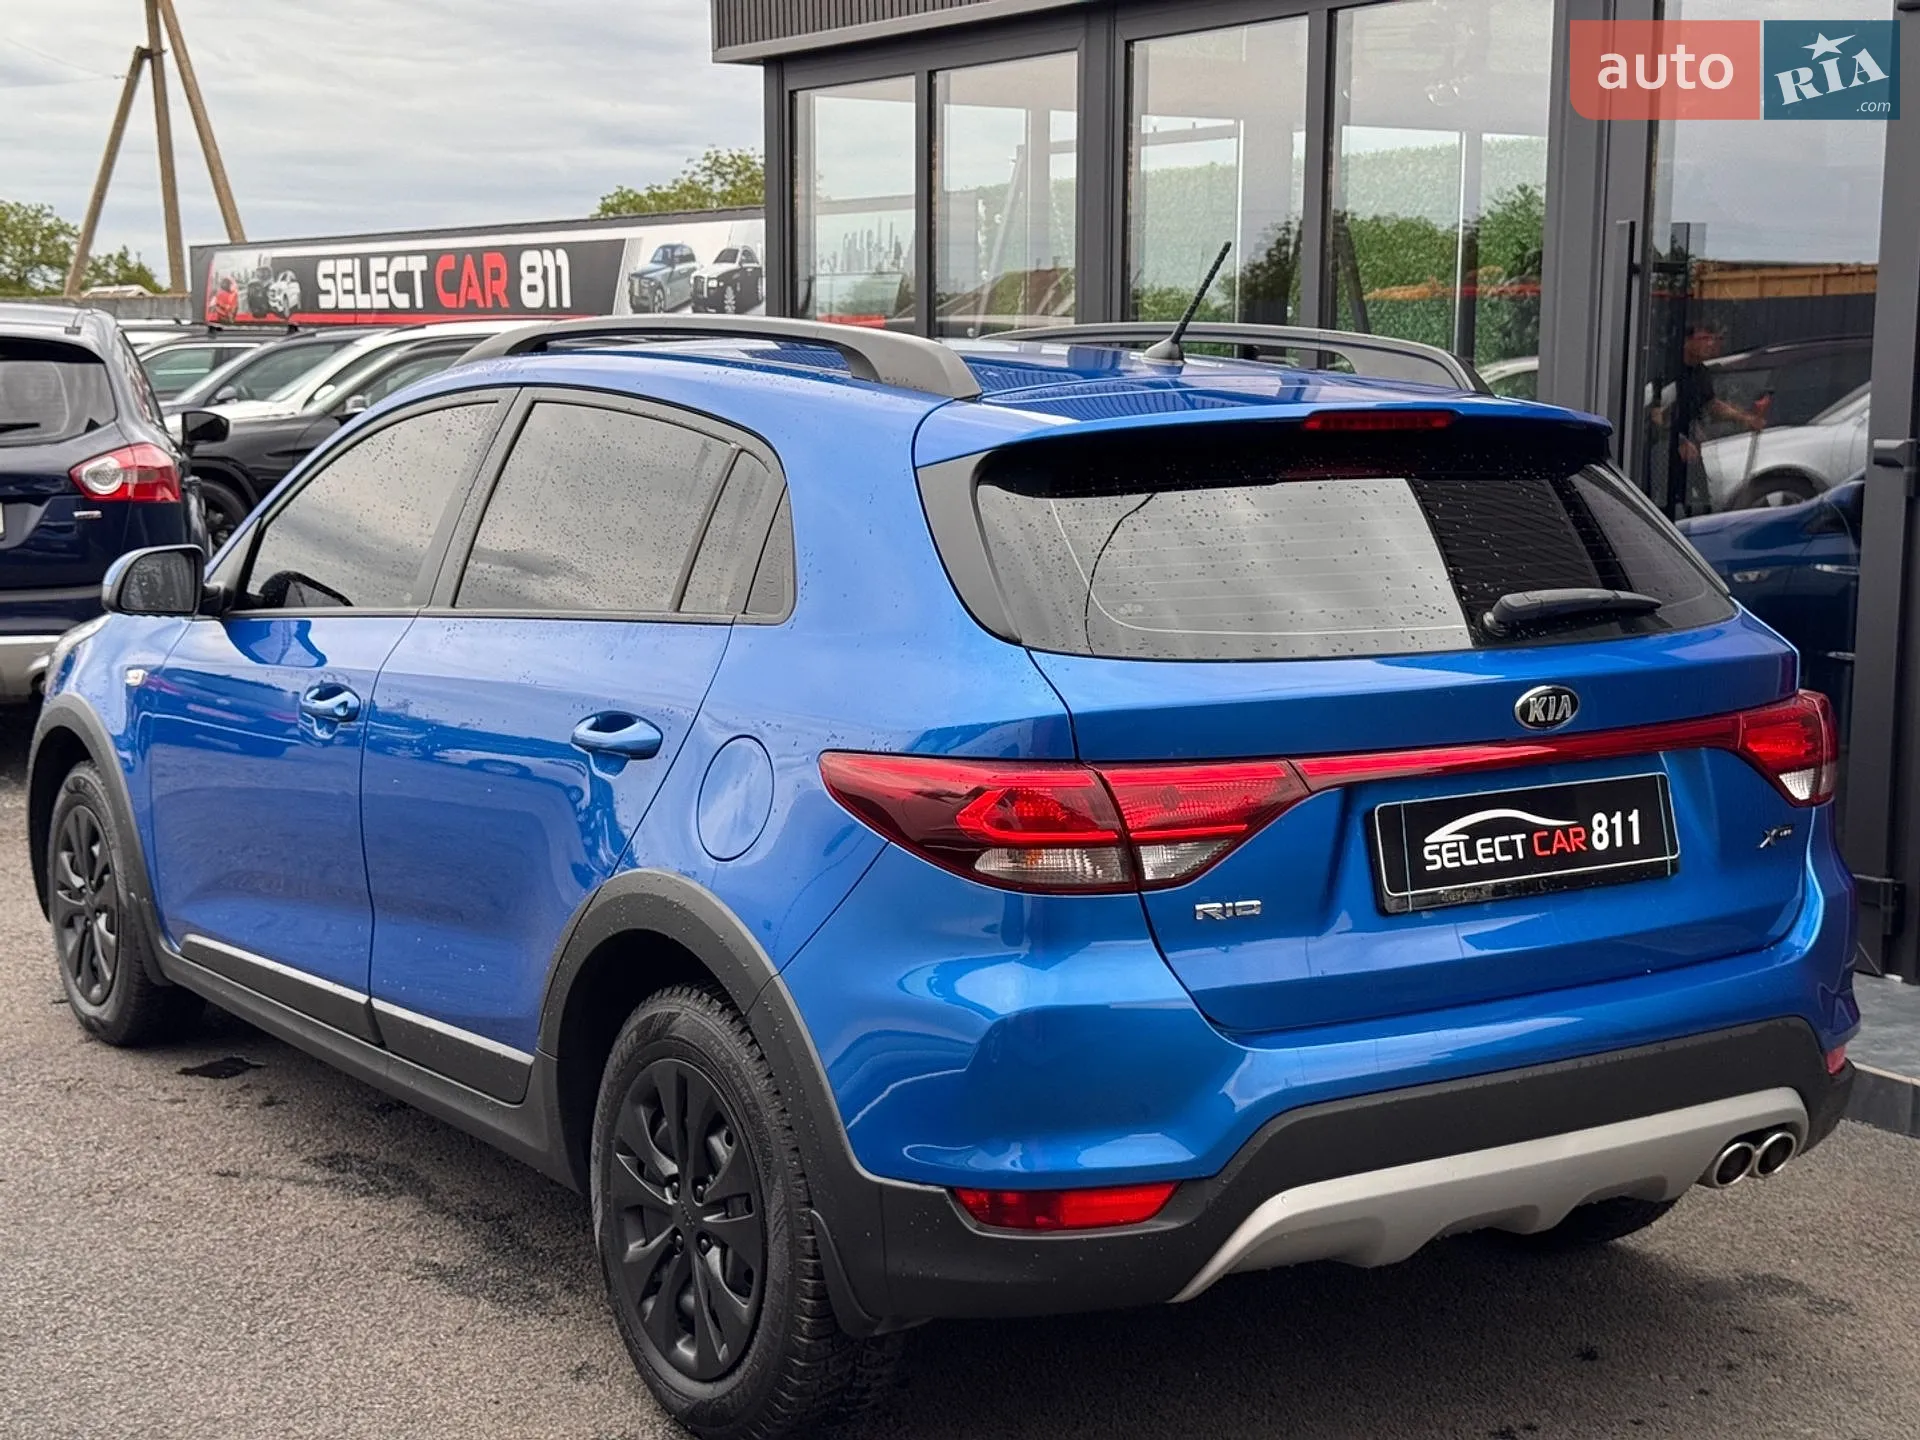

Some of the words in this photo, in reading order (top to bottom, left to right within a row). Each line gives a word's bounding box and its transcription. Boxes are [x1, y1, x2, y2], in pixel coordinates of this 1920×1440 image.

[316, 255, 428, 309] SELECT
[435, 252, 510, 309] CAR
[519, 248, 571, 309] 811
[1527, 694, 1572, 723] KIA
[1423, 833, 1527, 871] SELECT
[1532, 826, 1589, 857] CAR
[1591, 809, 1641, 851] 811
[1194, 900, 1262, 920] RIO
